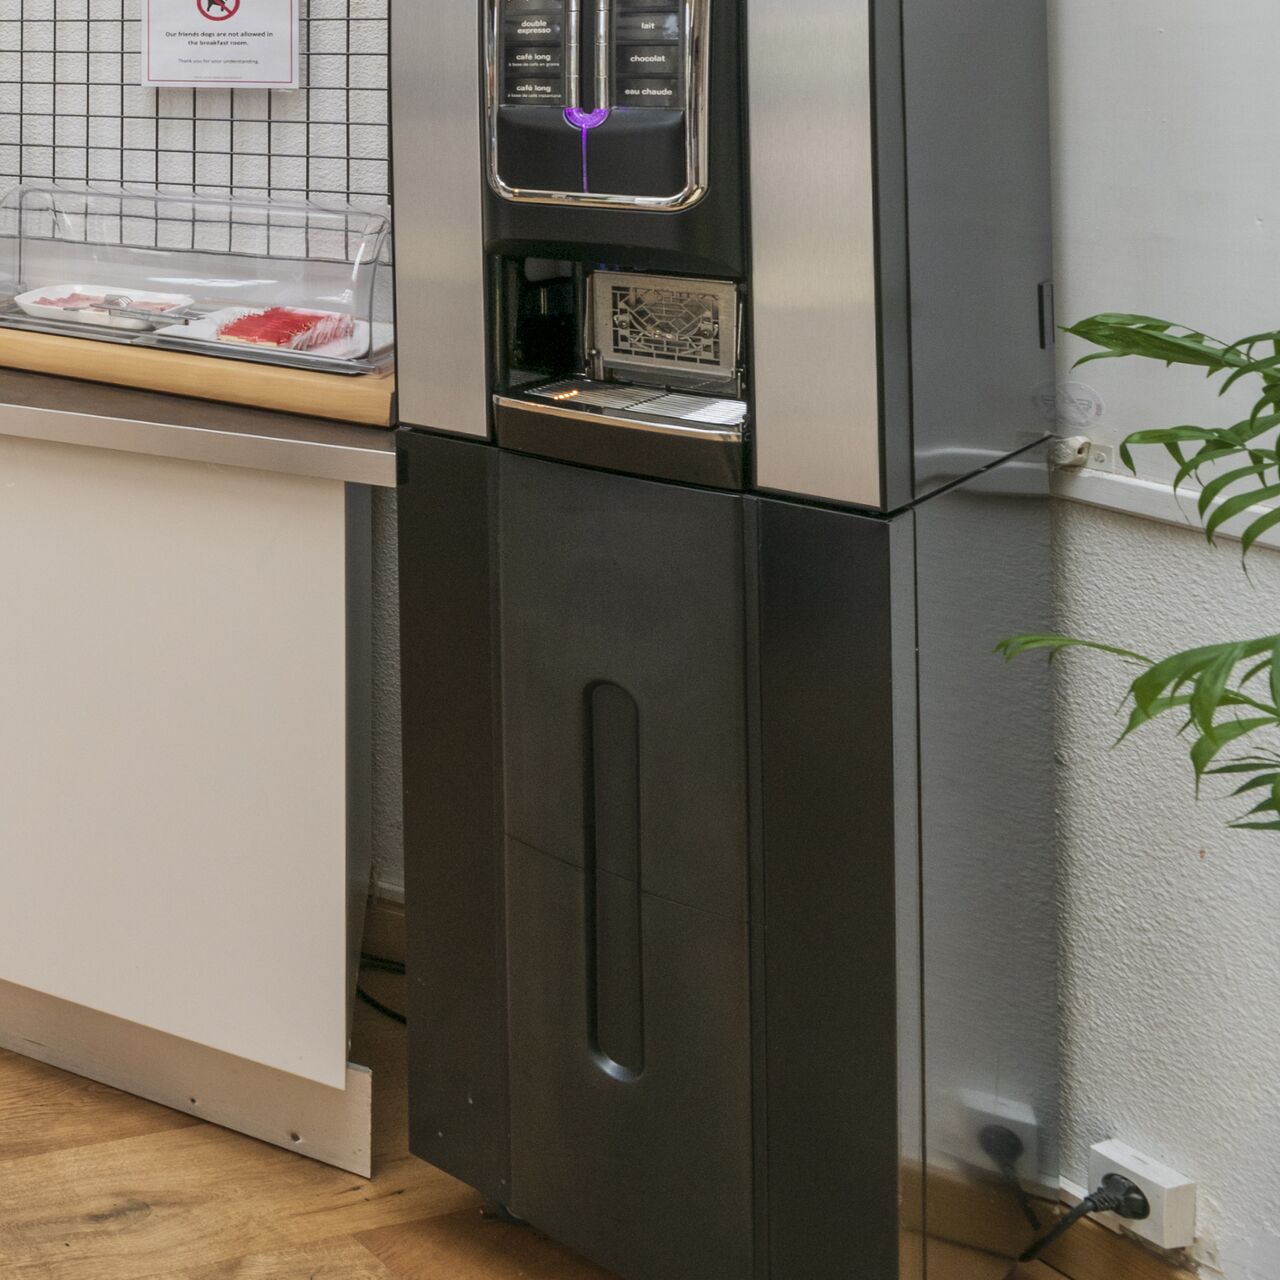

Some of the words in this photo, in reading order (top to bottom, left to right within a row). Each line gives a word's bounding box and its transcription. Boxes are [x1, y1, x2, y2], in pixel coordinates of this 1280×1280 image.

[641, 22, 655, 30] lait
[516, 52, 533, 60] café
[534, 52, 552, 62] long
[630, 54, 666, 62] chocolat
[516, 84, 533, 92] café
[534, 84, 552, 93] long
[641, 88, 672, 96] chaude
